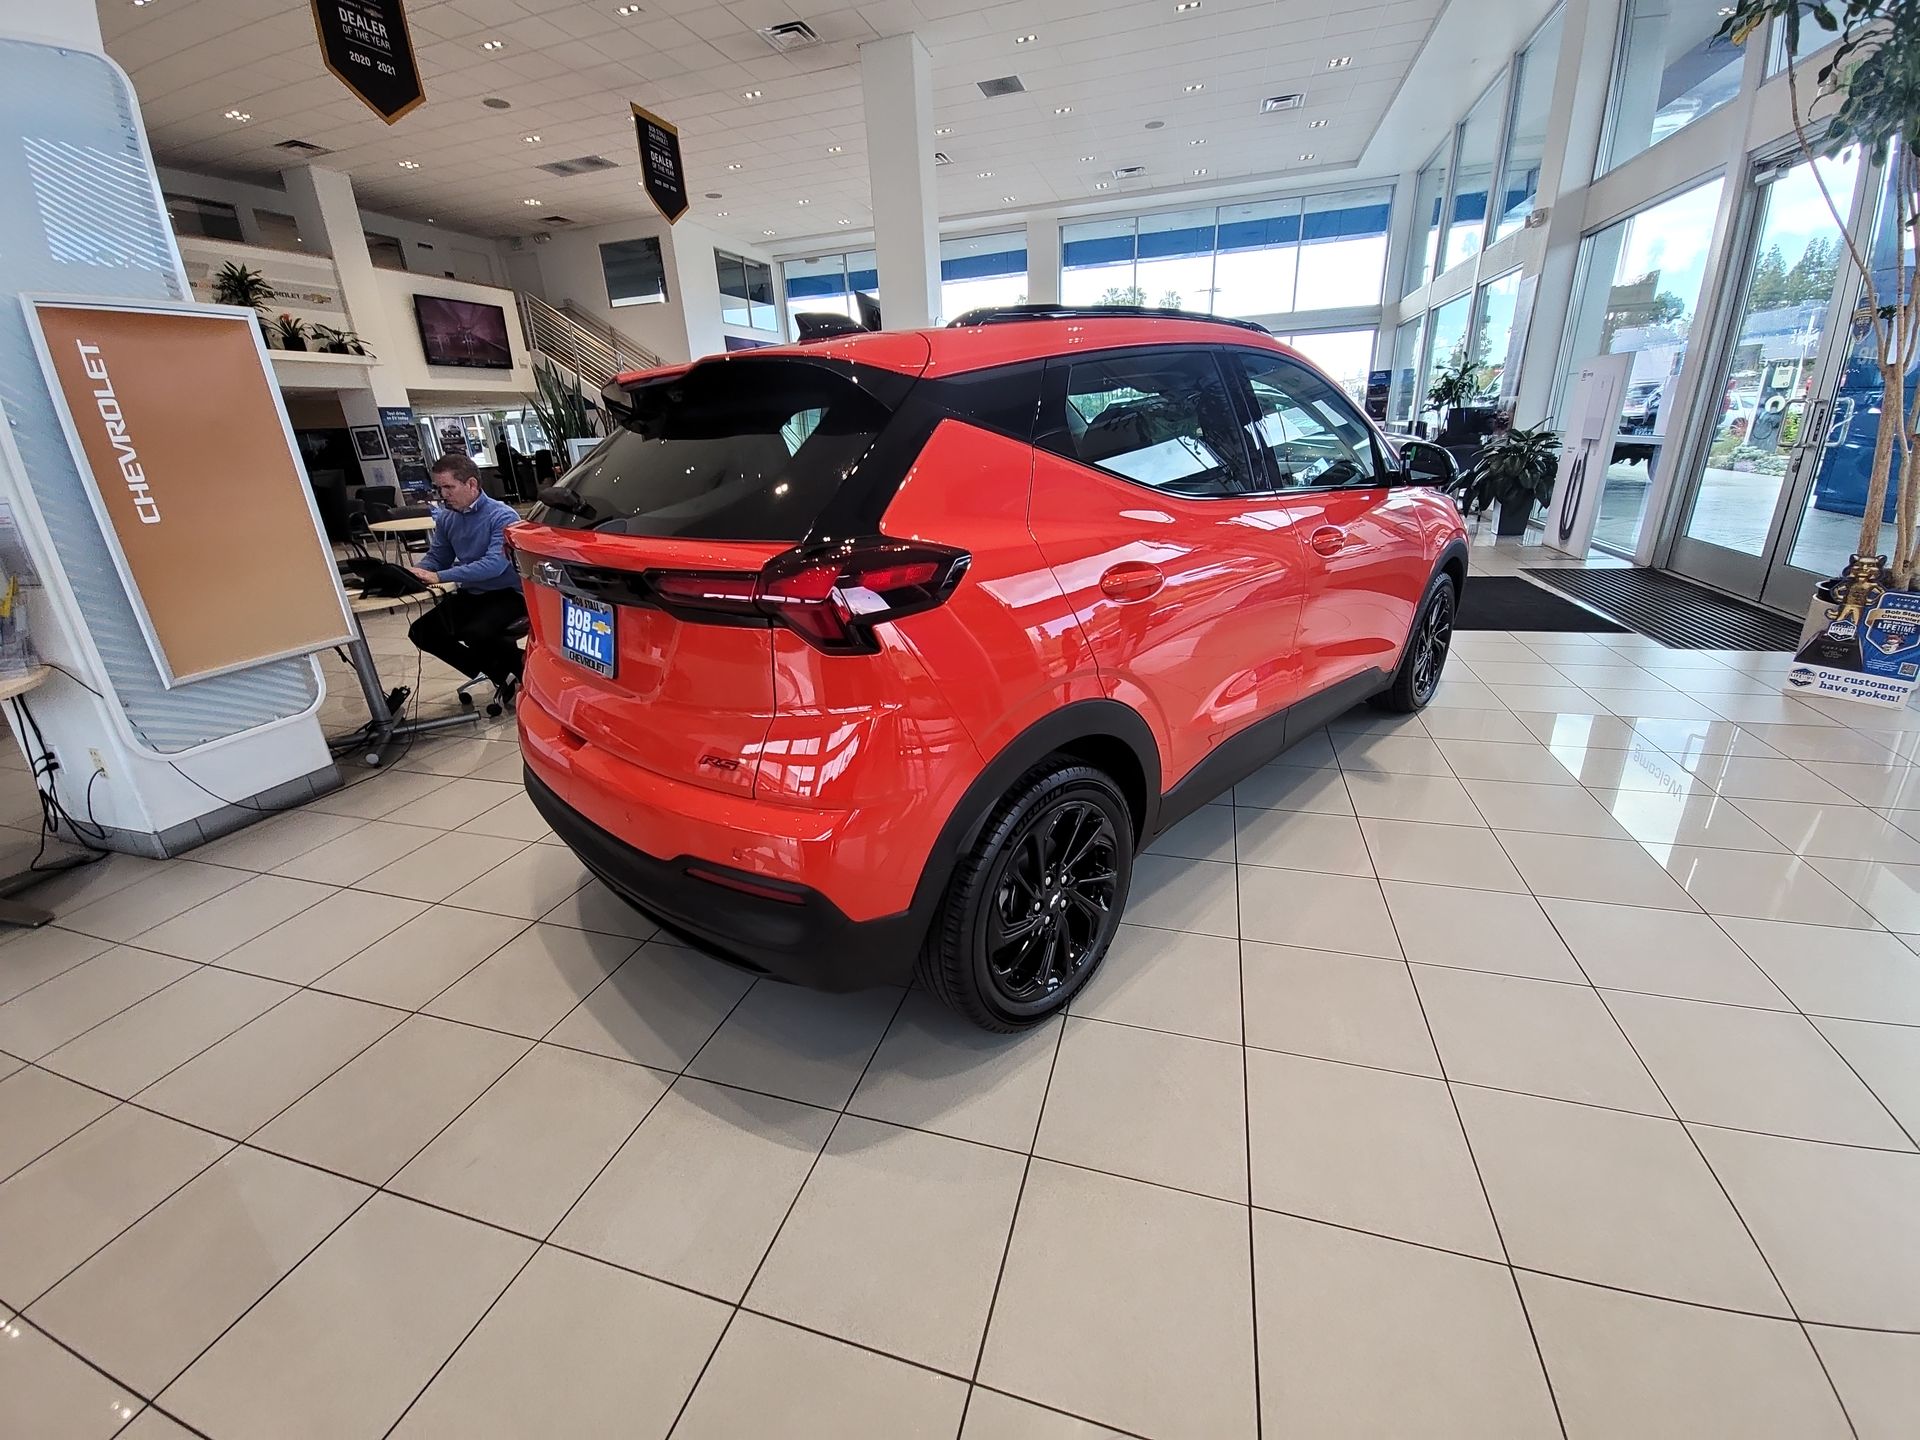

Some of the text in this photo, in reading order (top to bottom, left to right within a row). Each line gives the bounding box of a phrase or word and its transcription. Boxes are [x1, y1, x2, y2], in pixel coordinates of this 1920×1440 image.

[338, 6, 388, 39] DEALER
[342, 23, 391, 50] OF THE YEAR
[349, 51, 396, 76] 2020 2021
[650, 150, 674, 170] DEALER
[76, 338, 161, 524] CHEVROLET
[584, 598, 600, 613] STALL
[567, 606, 591, 633] BOB
[1877, 622, 1916, 634] LIFETIME
[1881, 614, 1920, 624] Chevrolet
[567, 627, 602, 659] STALL
[569, 650, 605, 674] CHEVROLET
[1818, 671, 1842, 682] Our
[1844, 676, 1909, 694] customers
[1819, 681, 1900, 703] have spoken!
[1633, 743, 1683, 802] Welcome
[1015, 787, 1062, 835] MICHELIN
